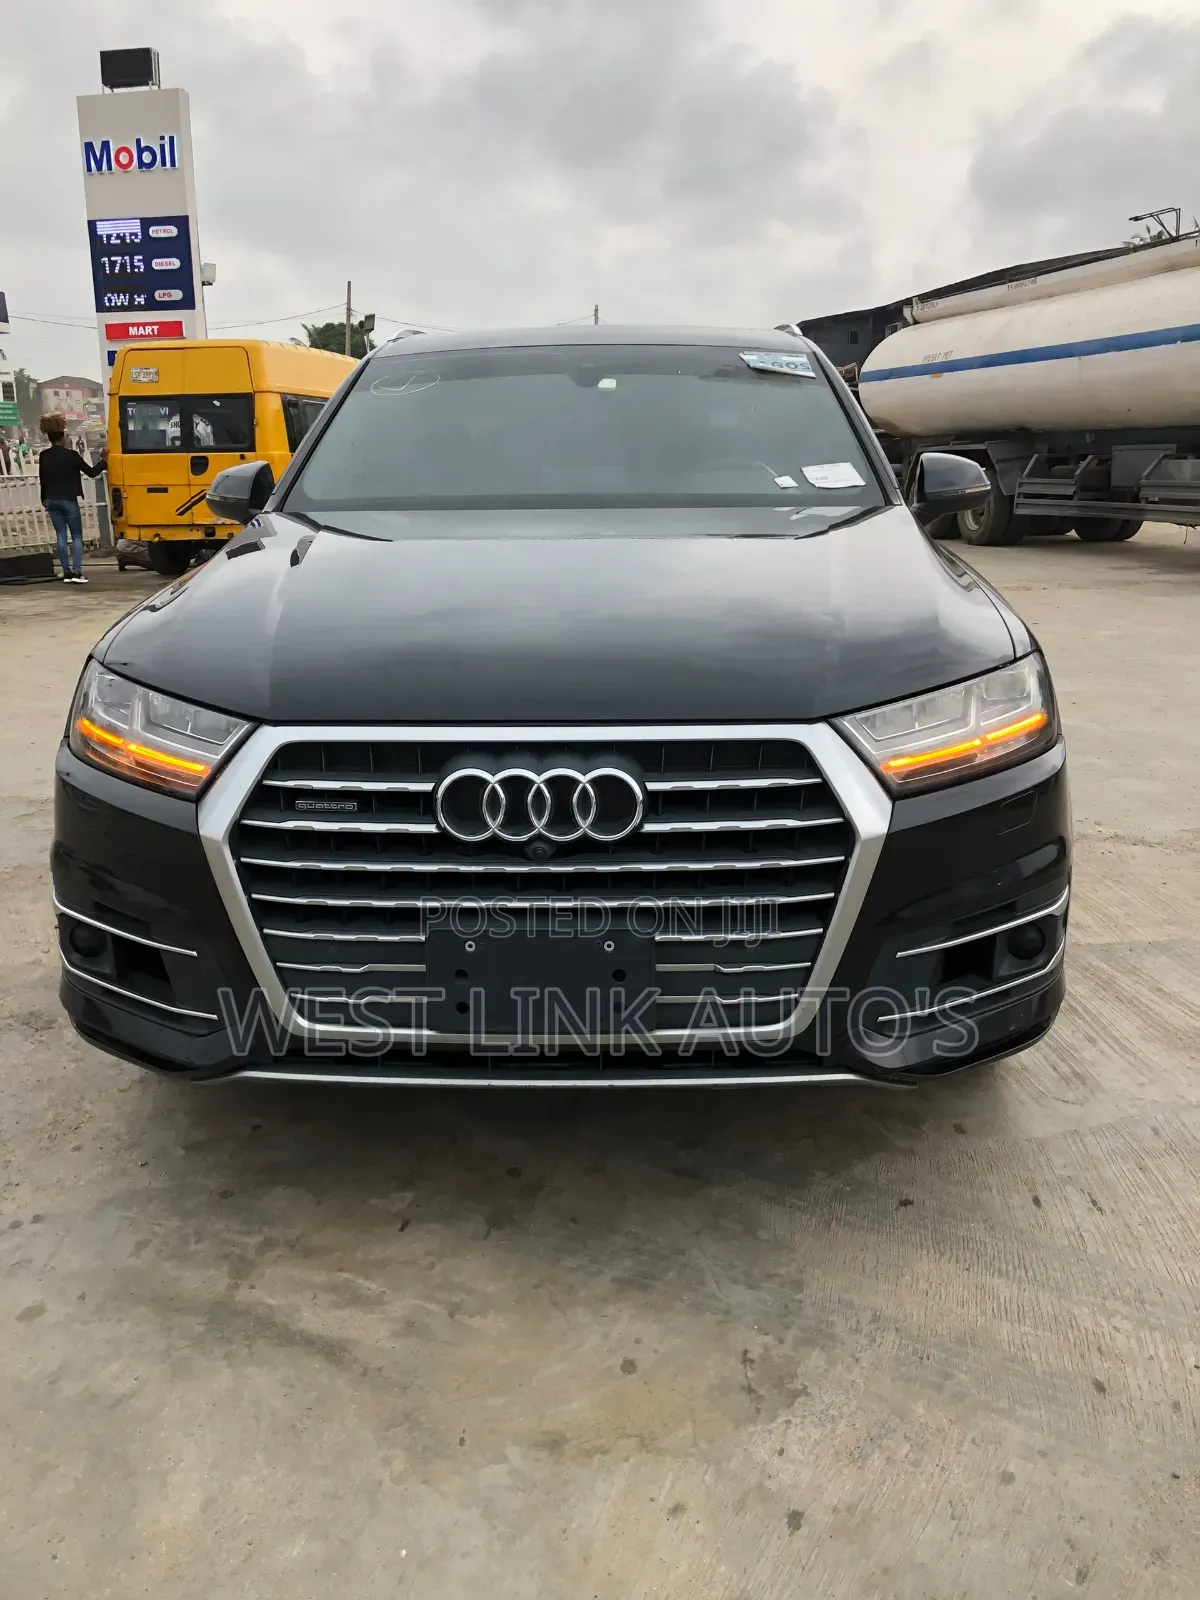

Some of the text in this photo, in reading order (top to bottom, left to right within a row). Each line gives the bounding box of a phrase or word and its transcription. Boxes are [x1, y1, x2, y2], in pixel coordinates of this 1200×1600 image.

[83, 135, 178, 173] Mobil
[100, 255, 145, 274] 1715
[158, 291, 173, 299] LPG
[128, 325, 160, 336] MART
